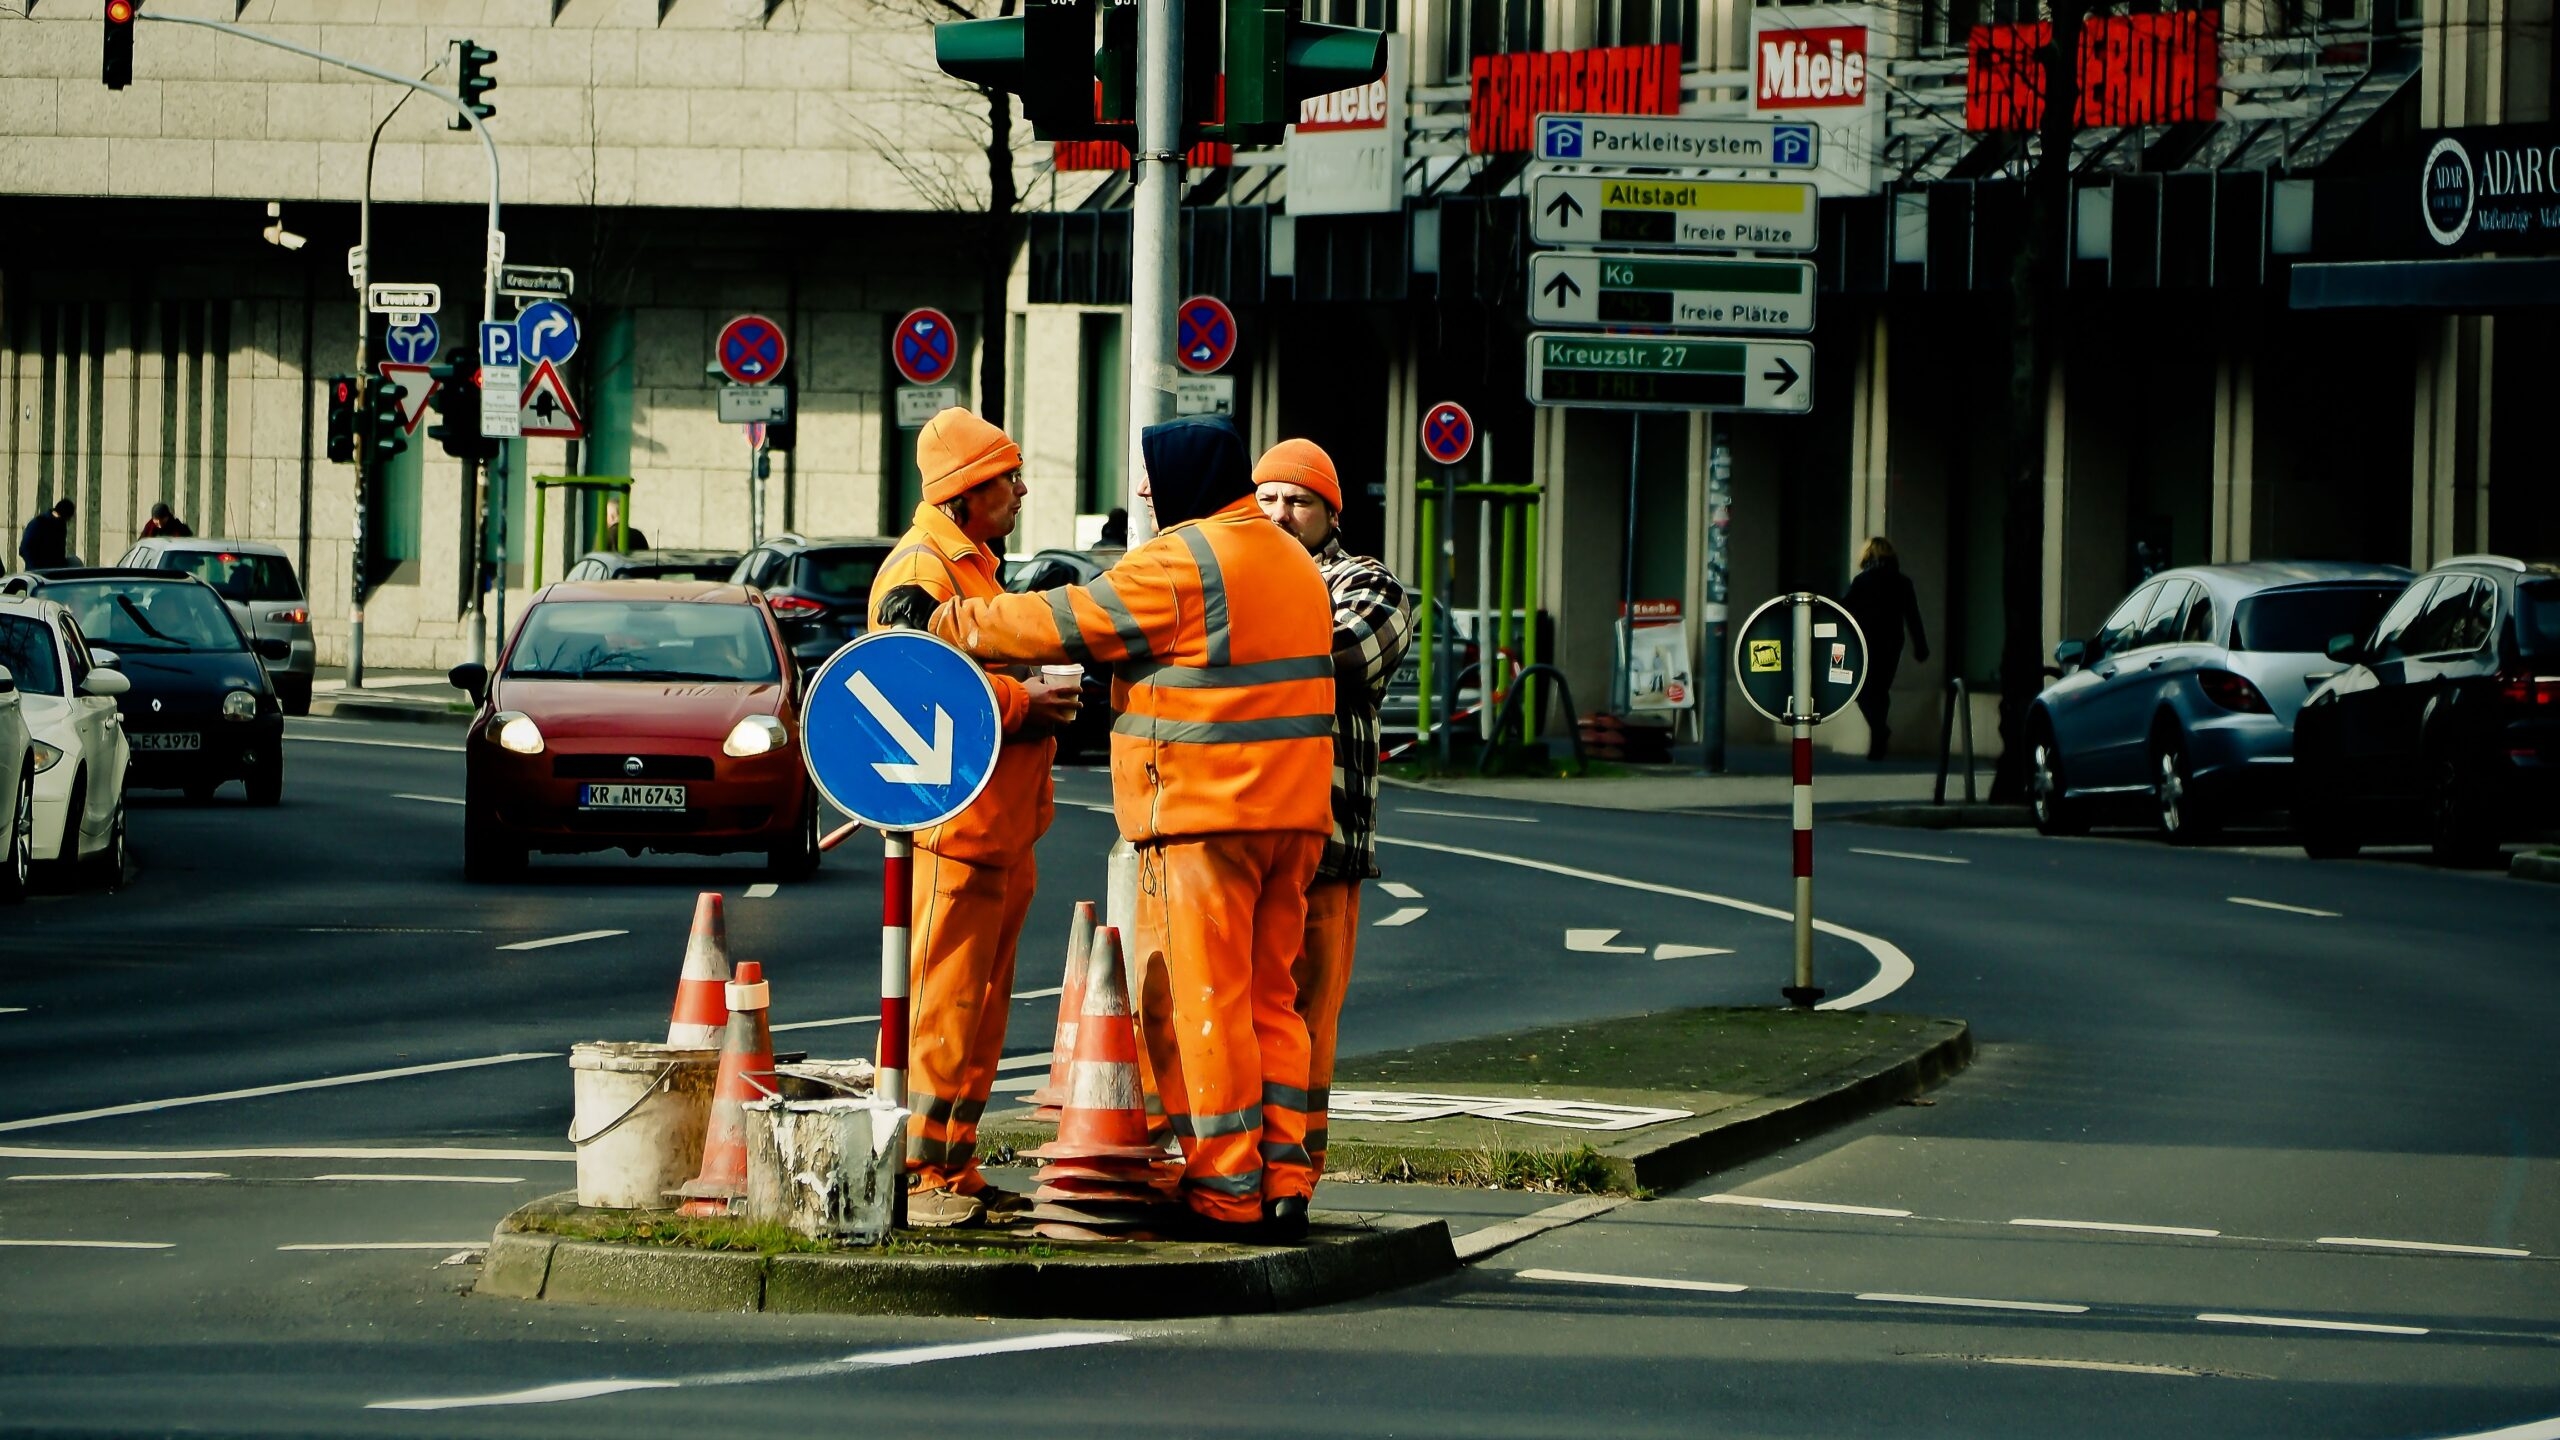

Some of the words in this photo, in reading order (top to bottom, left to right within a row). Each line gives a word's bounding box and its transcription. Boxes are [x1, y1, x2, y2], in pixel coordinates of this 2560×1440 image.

[1762, 39, 1864, 98] Miele
[1593, 130, 1762, 157] Parkleitsystem
[2479, 148, 2543, 195] ADAR
[1609, 185, 1697, 206] Altstadt
[1683, 223, 1726, 241] freie
[1735, 223, 1792, 243] Plätze
[1606, 265, 1634, 285] Kö
[1680, 304, 1723, 322] freie
[1732, 304, 1789, 324] Plätze
[1550, 344, 1650, 366] Kreuzstr.
[1661, 347, 1687, 367] 27
[142, 735, 160, 749] EK
[163, 735, 199, 749] 1978
[590, 787, 609, 803] KR
[622, 787, 641, 804] AM
[645, 788, 683, 805] 6743
